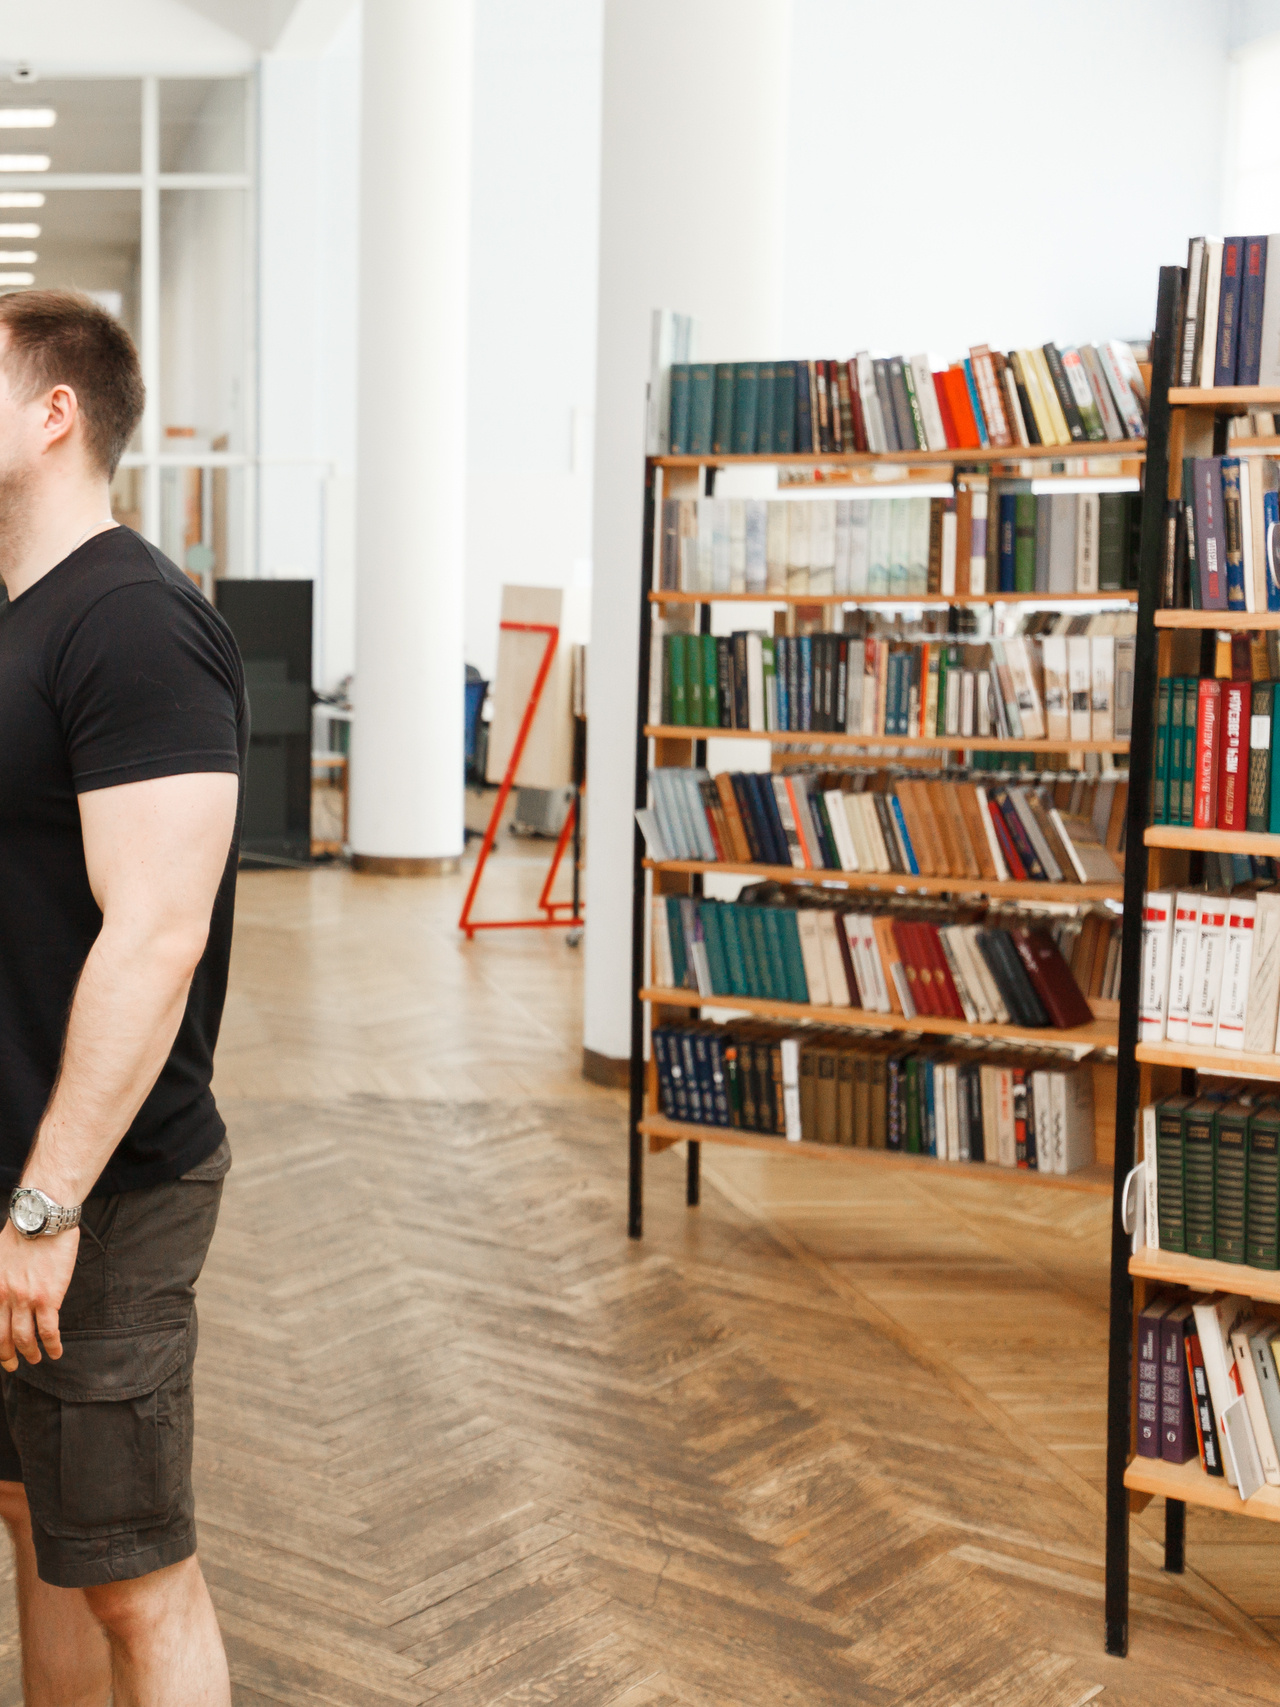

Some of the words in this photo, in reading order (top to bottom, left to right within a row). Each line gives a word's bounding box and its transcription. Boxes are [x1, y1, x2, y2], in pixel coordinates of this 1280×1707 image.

[1204, 698, 1216, 749] ЖЕНЩИН
[1227, 689, 1242, 738] ЗВЕЗДЫ
[1202, 749, 1213, 793] ВЛАСТЬ
